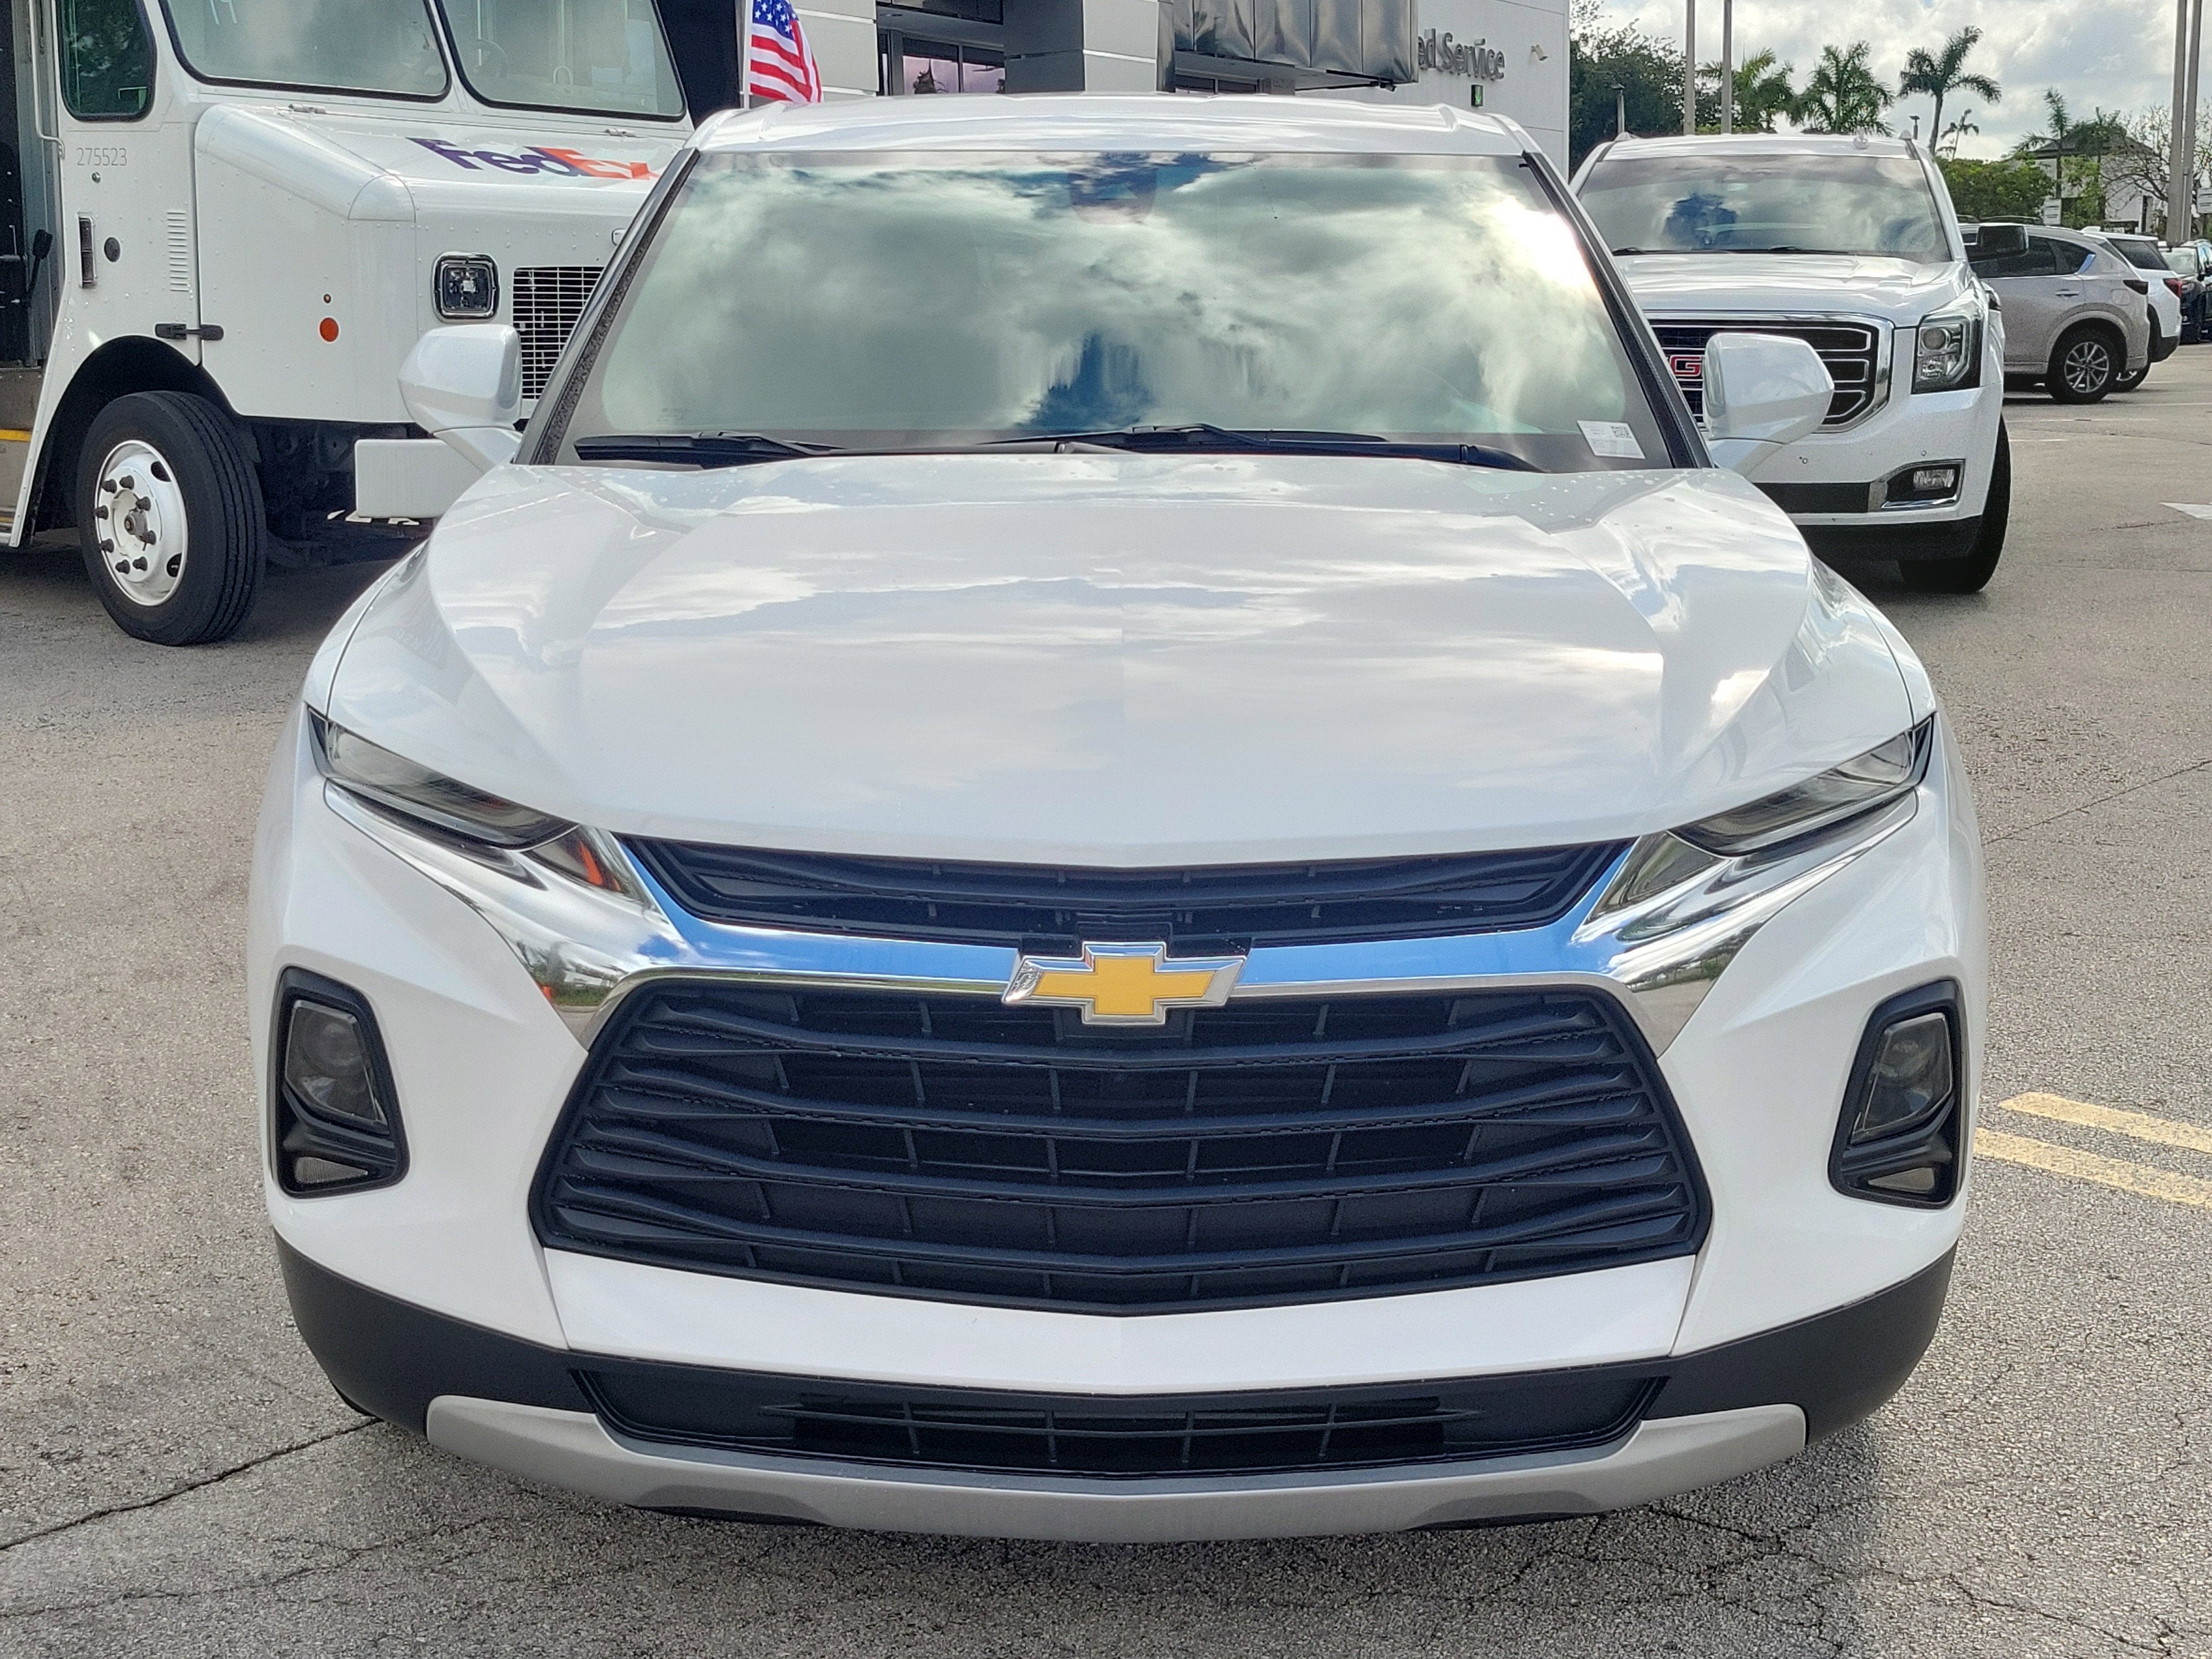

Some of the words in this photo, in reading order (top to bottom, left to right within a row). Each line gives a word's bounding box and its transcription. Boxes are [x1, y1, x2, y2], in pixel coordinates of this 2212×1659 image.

[1438, 32, 1505, 81] Service
[77, 148, 127, 166] 275523
[405, 137, 661, 180] FedEx
[1669, 354, 1705, 376] G
